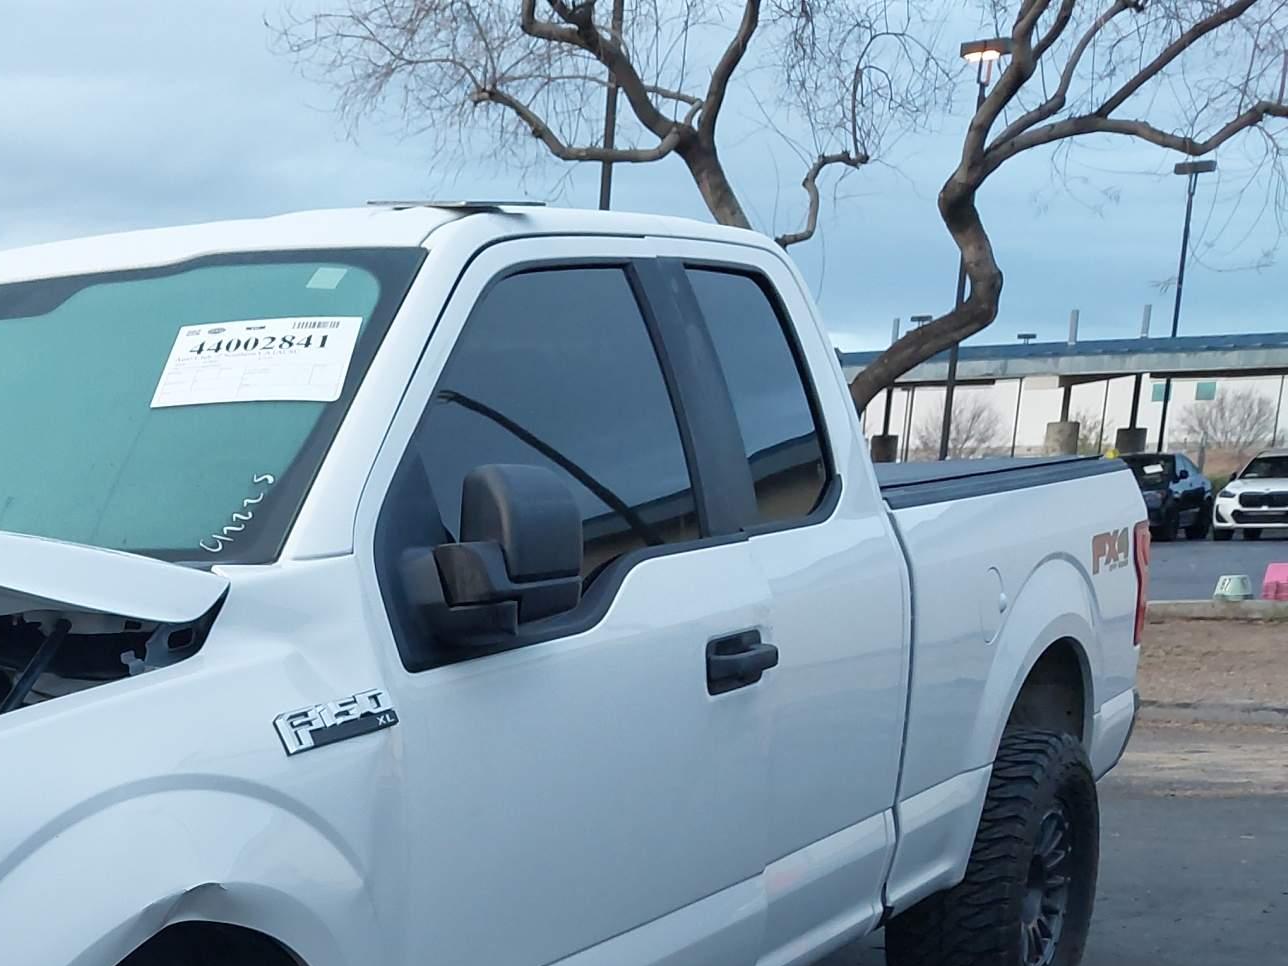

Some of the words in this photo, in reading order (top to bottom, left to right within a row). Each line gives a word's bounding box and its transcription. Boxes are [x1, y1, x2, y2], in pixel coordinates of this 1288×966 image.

[189, 334, 328, 355] 44002841
[1092, 527, 1129, 575] FX4
[376, 714, 395, 726] XL
